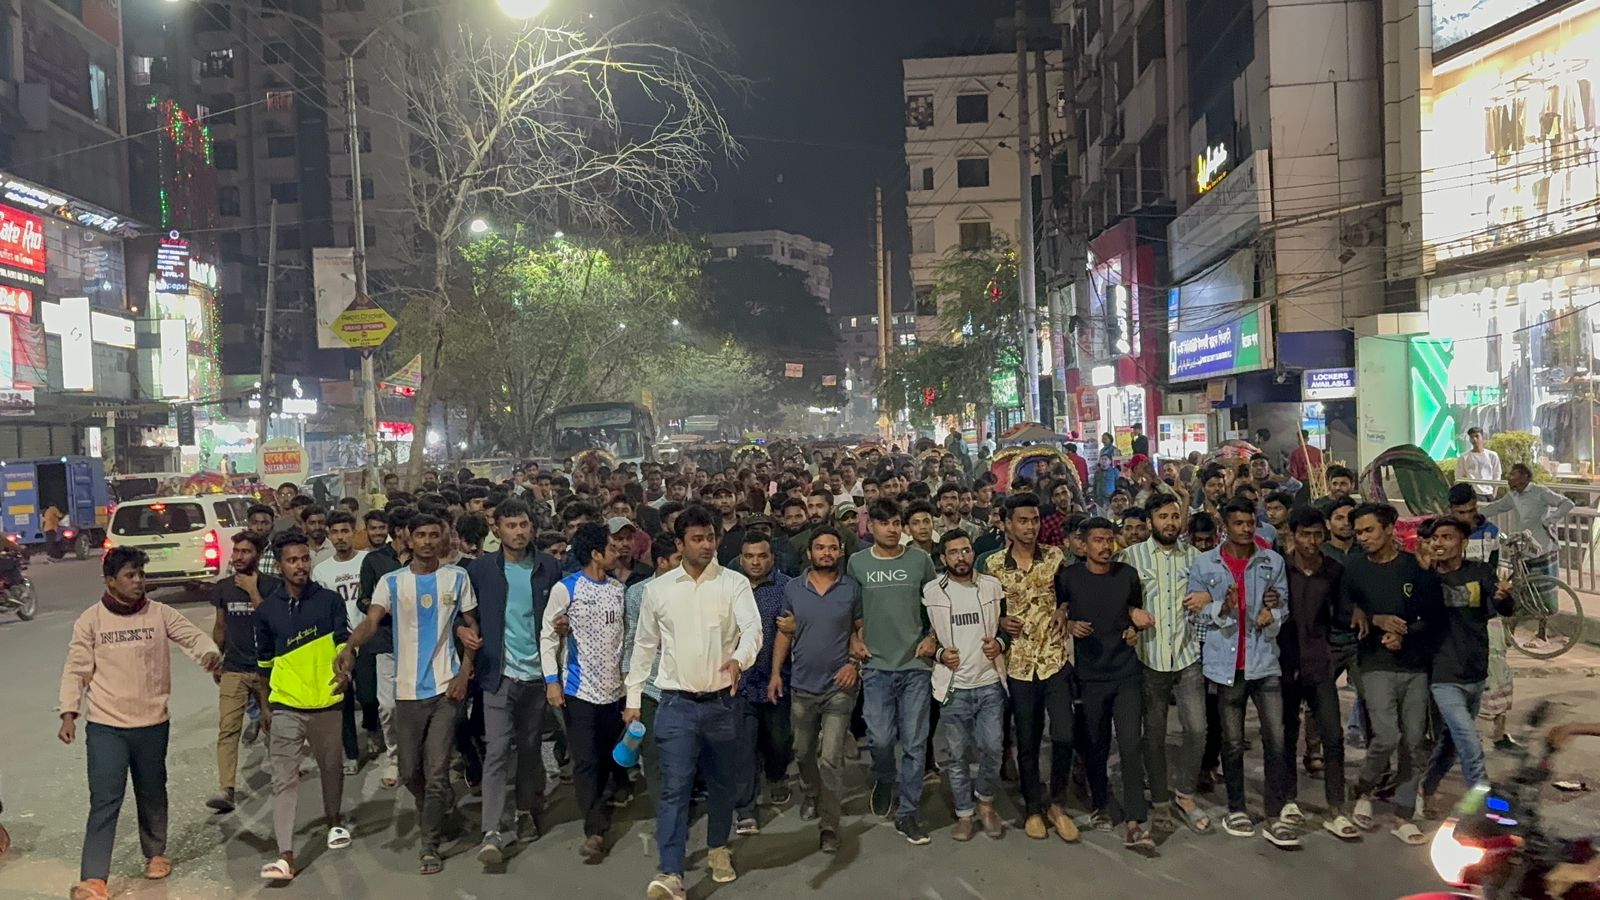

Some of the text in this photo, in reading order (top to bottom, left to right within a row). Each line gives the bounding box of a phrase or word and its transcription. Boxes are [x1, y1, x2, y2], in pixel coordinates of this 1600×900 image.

[1311, 380, 1351, 388] AVAILABLE
[1313, 373, 1348, 381] LOCKERS
[866, 569, 908, 583] KING
[605, 610, 615, 624] 10
[100, 627, 155, 645] NEXT
